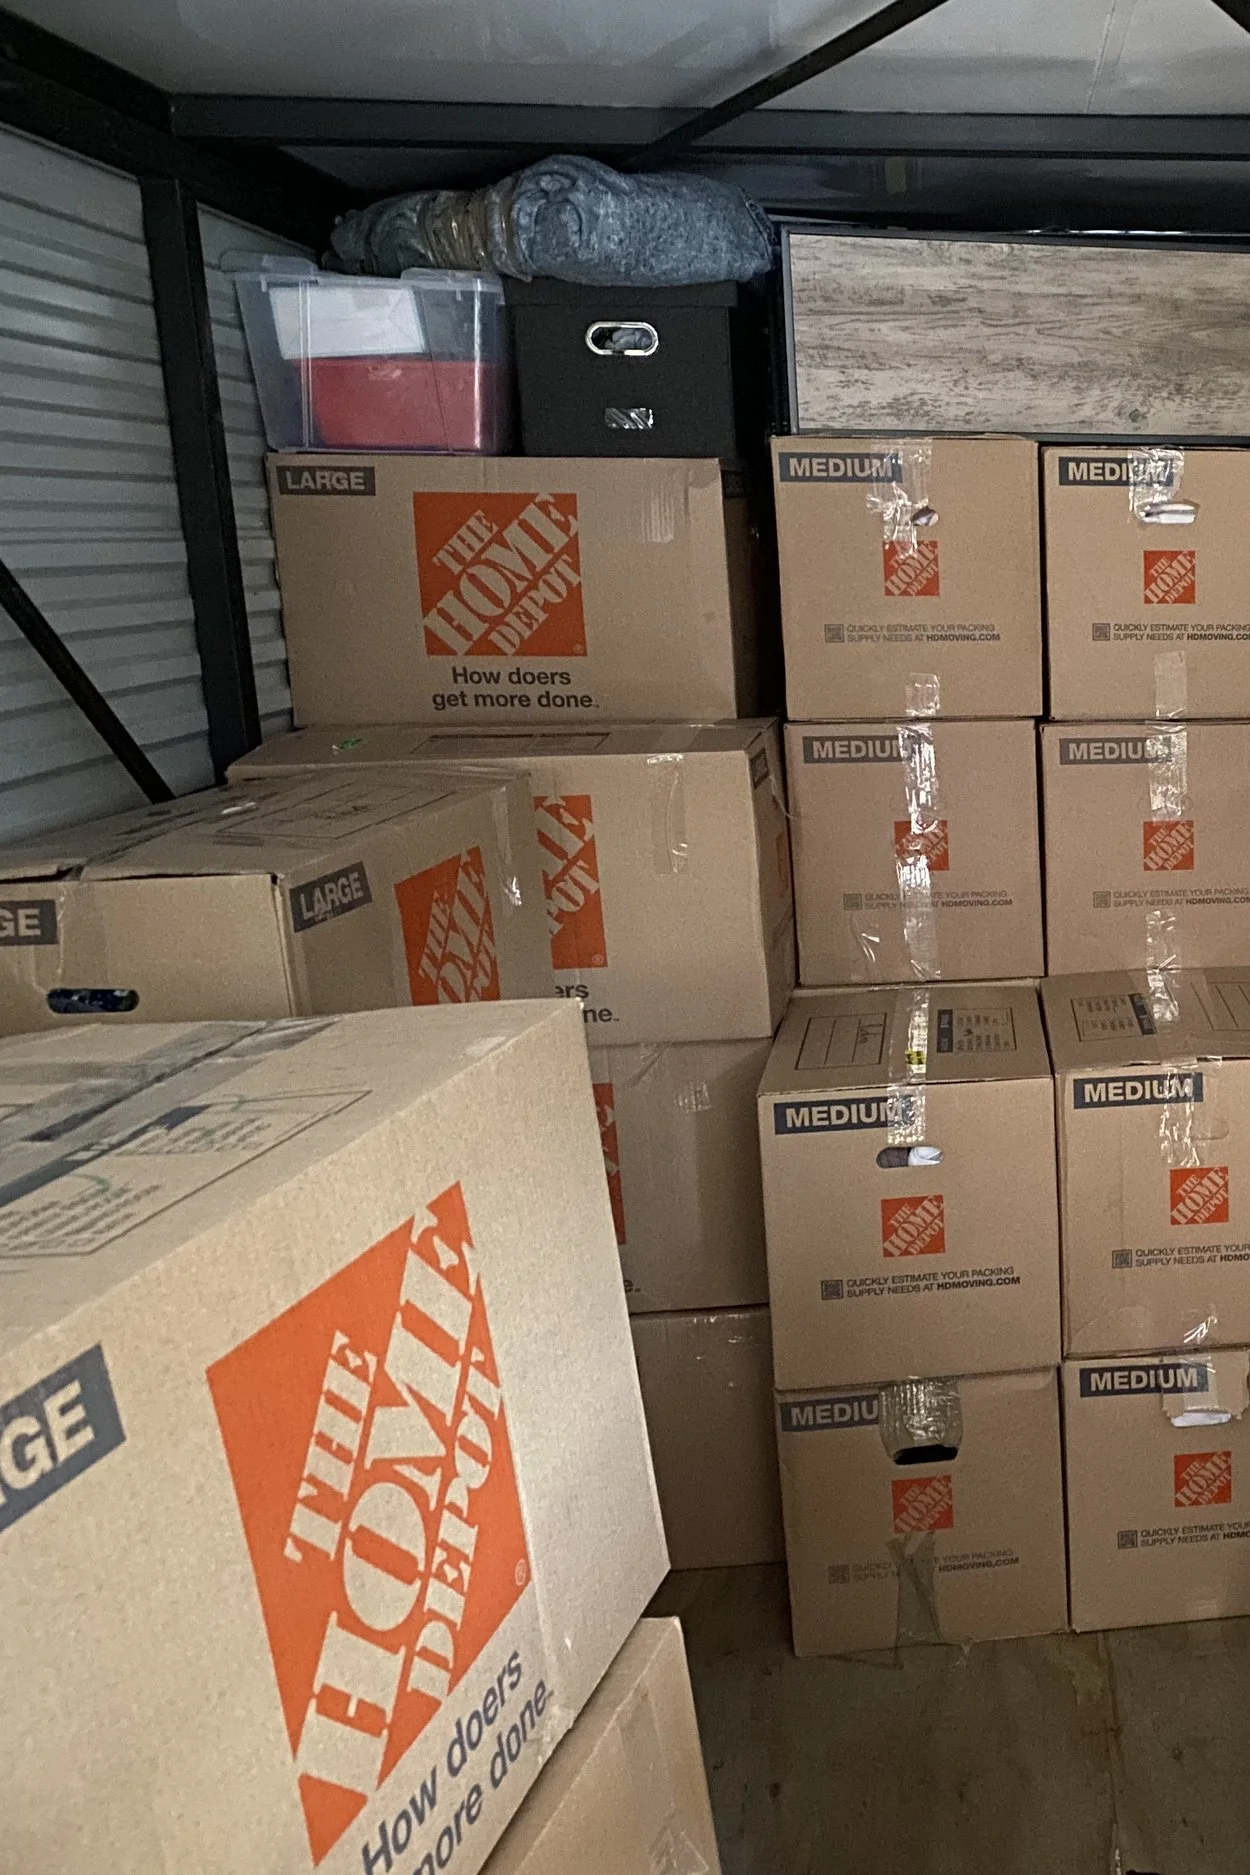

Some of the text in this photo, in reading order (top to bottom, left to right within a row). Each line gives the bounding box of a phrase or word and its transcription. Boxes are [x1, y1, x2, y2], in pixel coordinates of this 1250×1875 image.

[789, 457, 892, 477] MEDIUM
[286, 470, 365, 491] LARGE
[433, 508, 499, 575] THE
[423, 492, 580, 656] HOME
[884, 541, 939, 596] HOME
[906, 562, 939, 596] DEPOT
[1144, 550, 1196, 604] HOME
[1149, 556, 1171, 579] THE
[1164, 573, 1196, 604] DEPOT
[487, 554, 582, 656] DEPOT
[847, 623, 996, 633] QUICKLY ESTIMATE YOUR PACKING
[847, 634, 882, 643] SUPPLY
[914, 634, 925, 642] AT
[926, 633, 1001, 642] HDMOVING.COM
[1113, 623, 1148, 633] QUICKLY
[1150, 623, 1189, 632] ESTIMATE
[1190, 623, 1214, 632] YOUR
[1113, 633, 1145, 642] SUPPLY
[1146, 633, 1174, 642] NEEDS
[1175, 633, 1185, 641] AT
[451, 665, 572, 686] How doers
[431, 691, 470, 710] get
[474, 690, 532, 708] more
[1144, 820, 1194, 871] HOME
[300, 871, 365, 922] LARGE
[941, 899, 1013, 908] HDMOVING.COM
[1113, 888, 1249, 899] QUICKLY ESTIMATE YOUR PACKING
[1113, 898, 1145, 908] SUPPLY
[418, 889, 450, 985] THE
[437, 851, 486, 1004] OME
[555, 984, 590, 999] ers
[1084, 1078, 1194, 1103] MEDIUM
[786, 1101, 900, 1128] MEDIUM
[1170, 1167, 1229, 1225] HOME
[1174, 1173, 1201, 1199] THE
[889, 1203, 914, 1229] THE
[1193, 1188, 1229, 1225] DEPOT
[883, 1195, 944, 1257] HOME
[907, 1219, 945, 1256] DEPOT
[1135, 1247, 1176, 1258] QUICKLY
[1178, 1244, 1222, 1256] ESTIMATE
[1223, 1243, 1250, 1254] YOUR
[1135, 1256, 1172, 1268] SUPPLY
[1173, 1254, 1205, 1266] NEEDS
[1206, 1253, 1218, 1263] AT
[847, 1266, 1015, 1289] QUICKLY ESTIMATE YOUR PACKING
[847, 1276, 1021, 1298] SUPPLY NEEDS AT HDMOVING.COM
[1091, 1368, 1198, 1392] MEDIUM
[790, 1401, 880, 1427] MEDIU
[283, 1330, 378, 1564] THE
[1174, 1450, 1232, 1507] HOME
[1182, 1460, 1203, 1481] THE
[294, 1203, 481, 1800] HOME
[1198, 1472, 1232, 1506] DEPOT
[894, 1475, 952, 1533] HOME
[407, 1348, 503, 1704] DEPOT
[1140, 1527, 1180, 1538] QUICKLY
[1181, 1523, 1226, 1534] ESTIMATE
[1140, 1536, 1176, 1547] SUPPLY
[1177, 1533, 1208, 1544] NEEDS
[1209, 1532, 1220, 1541] AT
[938, 1556, 1019, 1573] HDMOVING.COM
[361, 1650, 522, 1875] How doers
